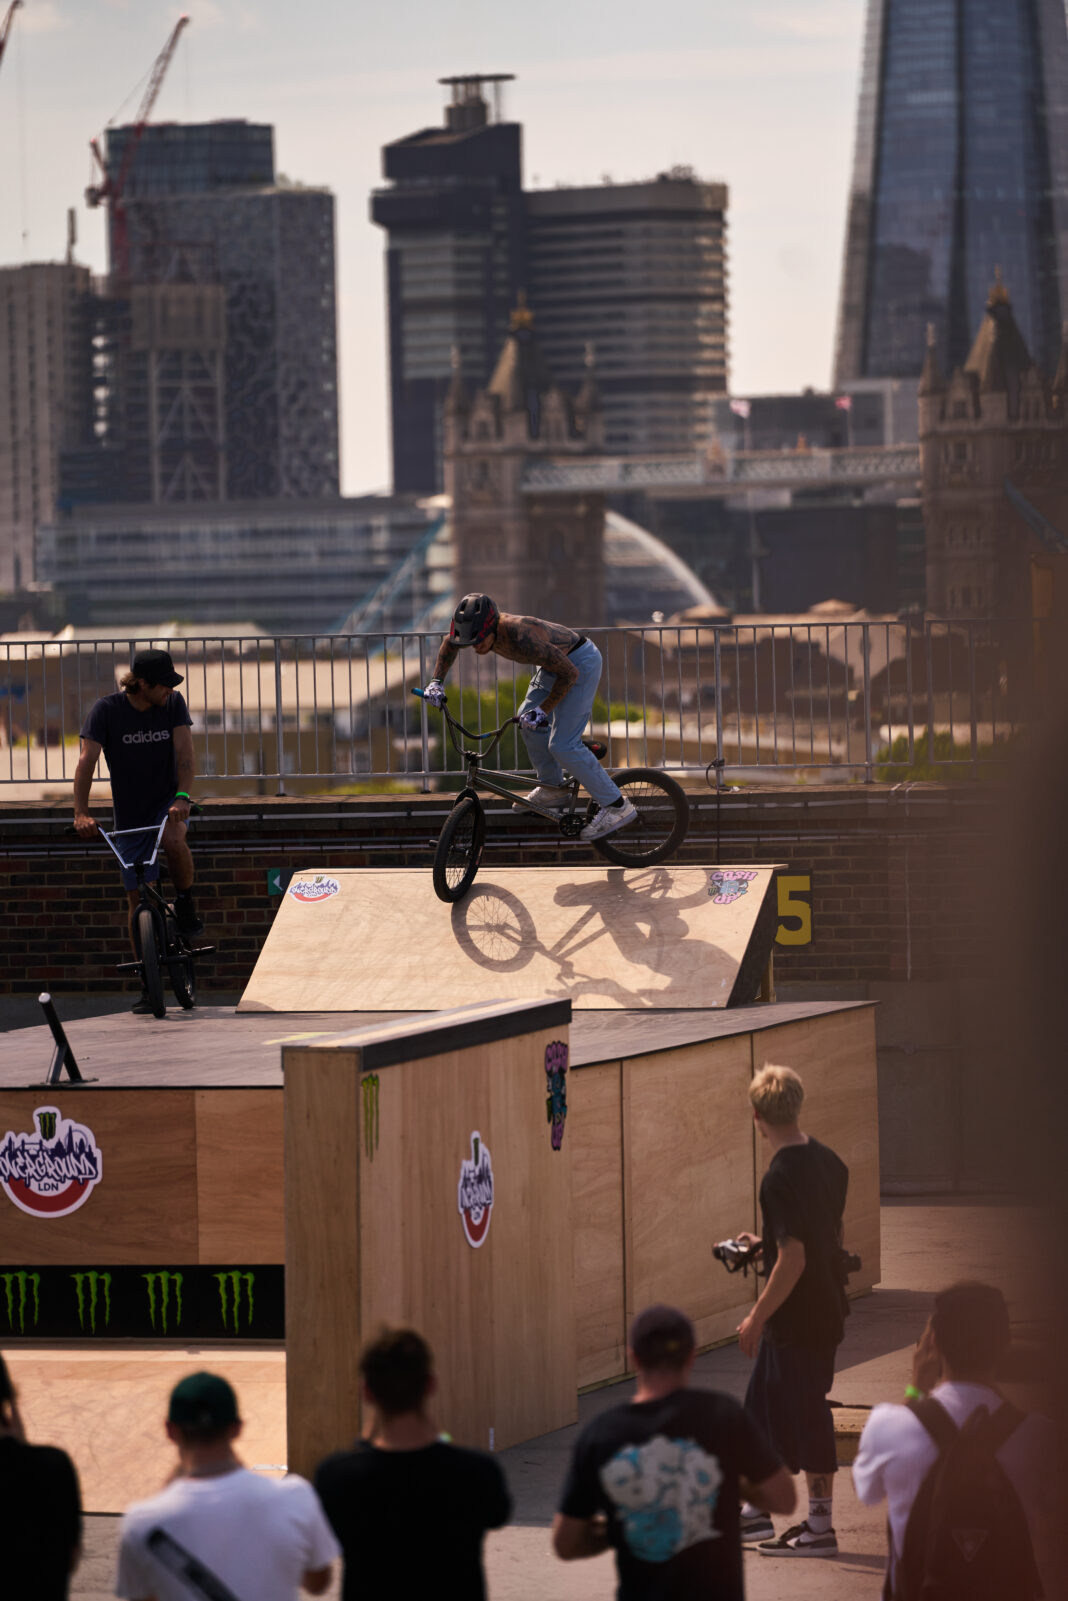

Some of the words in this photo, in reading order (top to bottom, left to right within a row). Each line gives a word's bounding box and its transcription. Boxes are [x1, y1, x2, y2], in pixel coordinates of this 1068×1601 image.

[122, 730, 170, 744] adidas
[775, 875, 812, 946] 5
[38, 1183, 59, 1192] LDN
